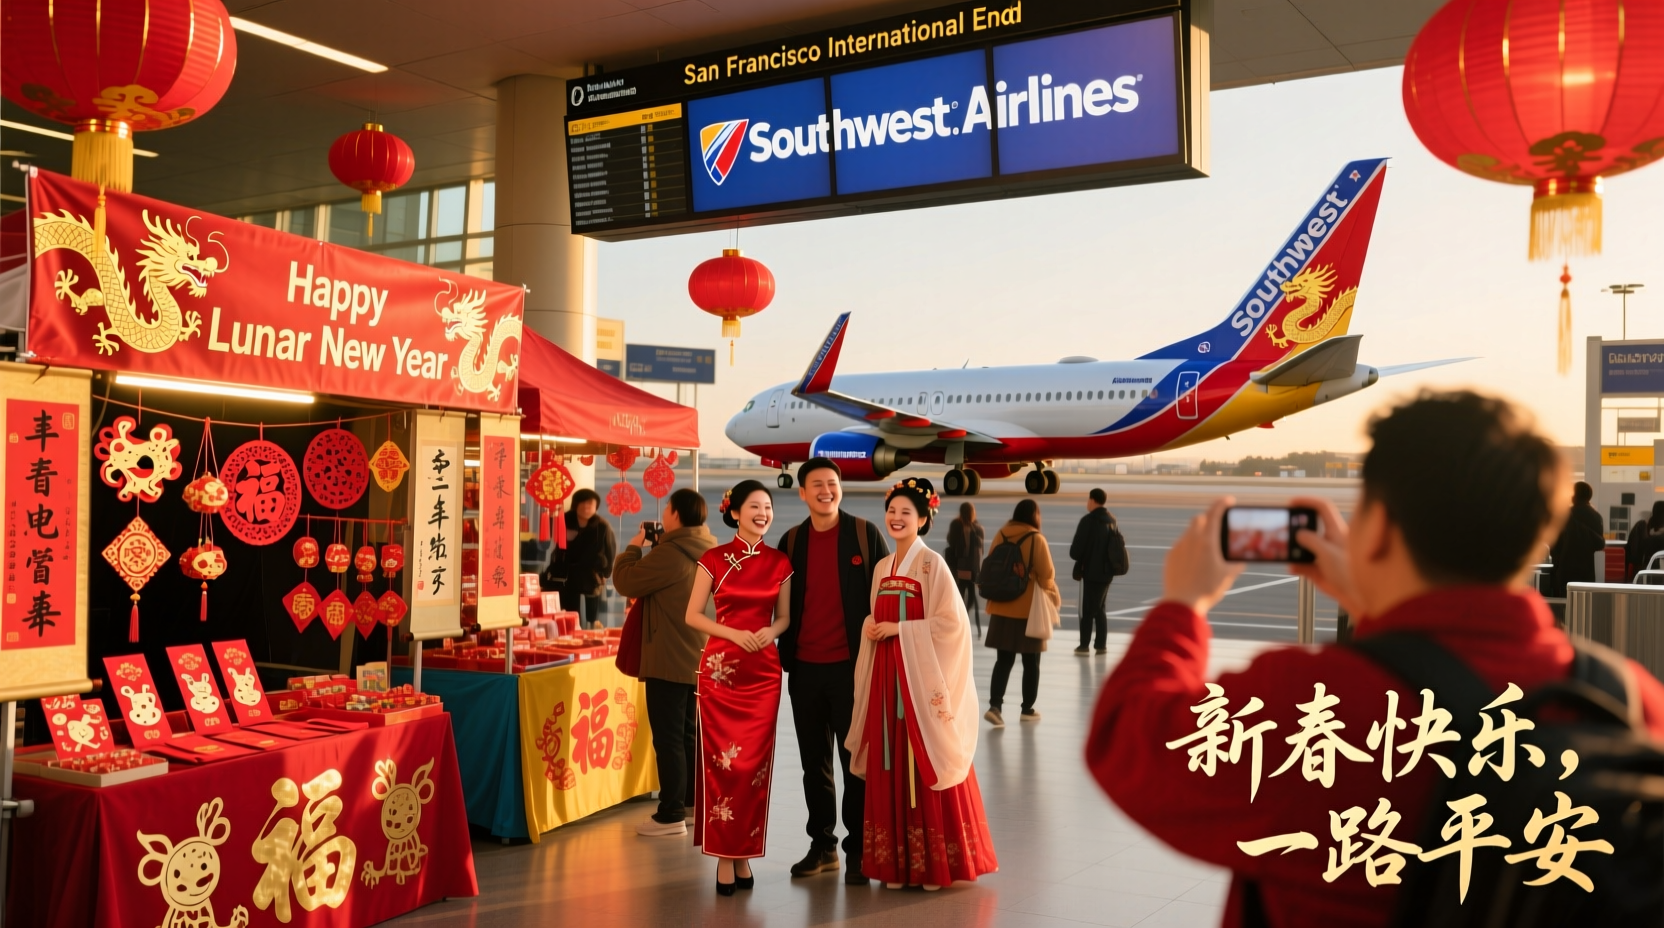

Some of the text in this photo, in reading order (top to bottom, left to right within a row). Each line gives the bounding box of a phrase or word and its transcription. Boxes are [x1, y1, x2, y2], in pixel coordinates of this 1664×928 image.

[684, 64, 719, 85] San
[727, 45, 821, 77] Francisco
[828, 11, 964, 58] International
[962, 73, 1140, 134] Airlines
[287, 260, 389, 327] Happy
[1231, 190, 1348, 337] Southwest
[207, 306, 449, 380] Lunar New Year
[235, 458, 287, 523] 福
[571, 688, 614, 775] 福
[252, 768, 357, 924] 福
